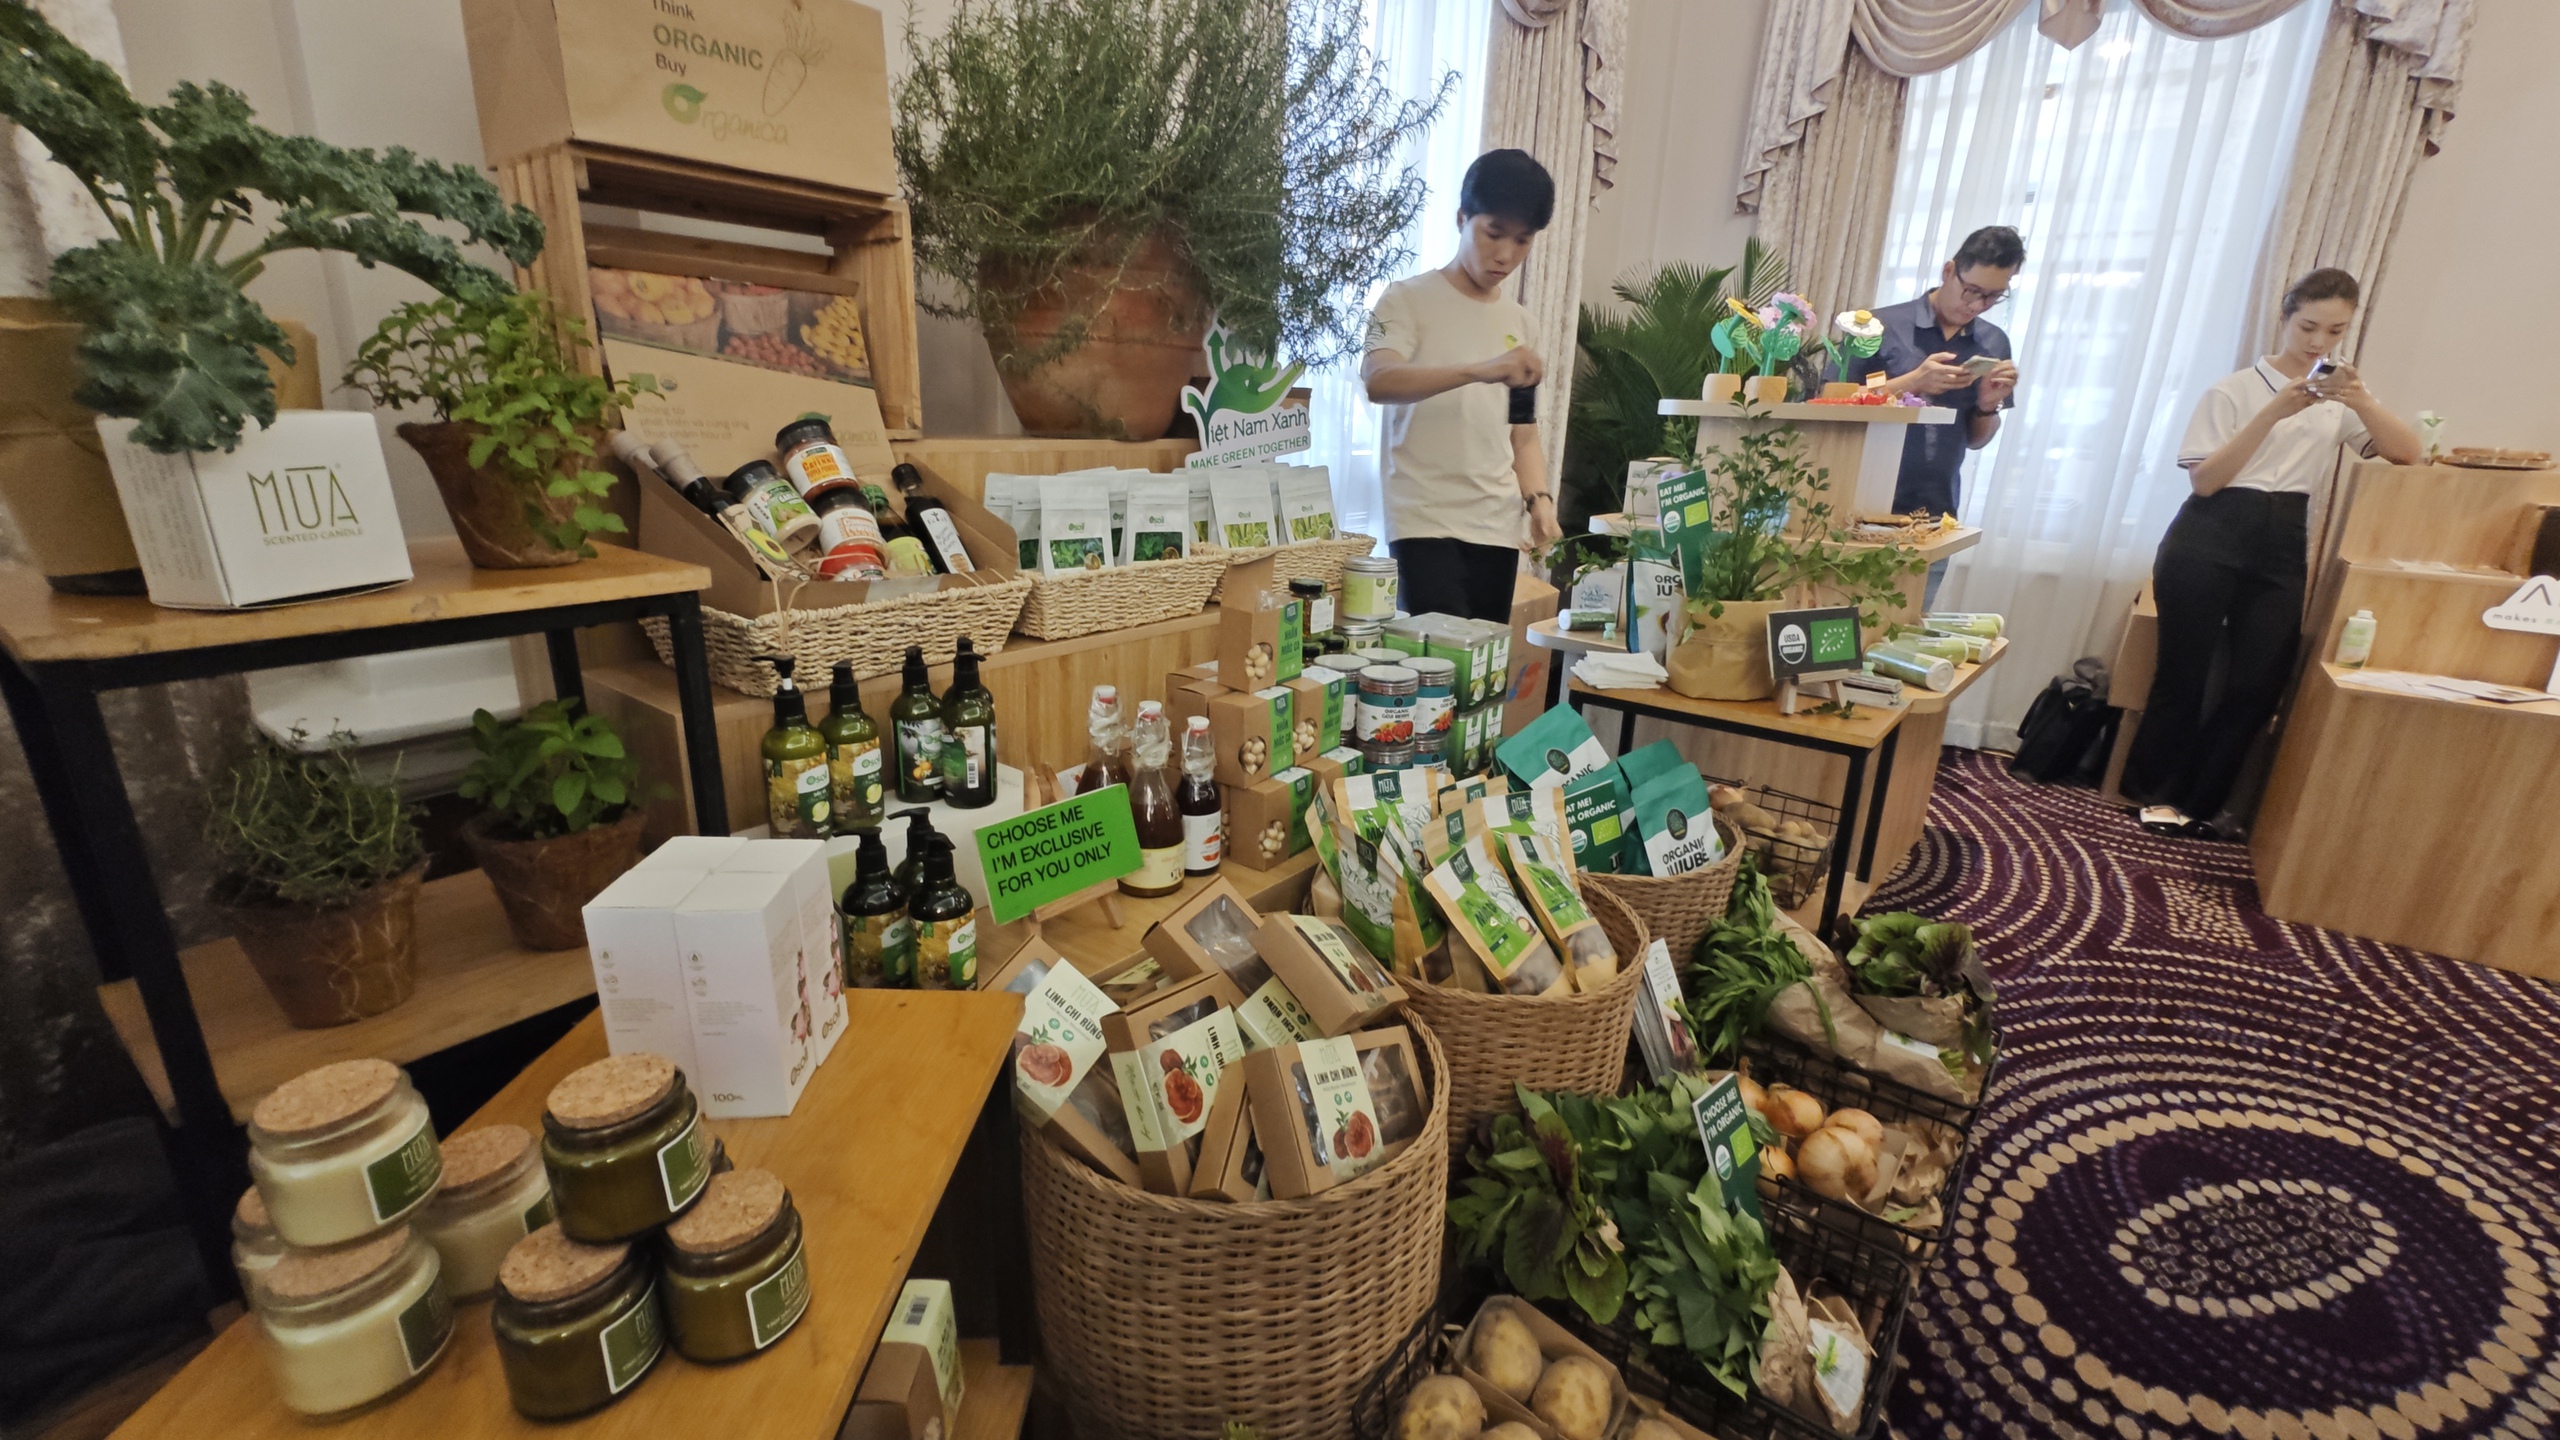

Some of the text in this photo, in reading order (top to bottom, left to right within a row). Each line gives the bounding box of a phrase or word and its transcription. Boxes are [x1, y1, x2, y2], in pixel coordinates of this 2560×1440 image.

[653, 24, 764, 71] ORGANIC
[655, 53, 686, 77] Buy
[1233, 418, 1269, 439] Nam
[1272, 408, 1308, 431] Xanh
[1190, 435, 1309, 469] MAKE GREEN TOGETHER
[1659, 486, 1673, 498] EAT
[1673, 486, 1706, 504] ORGANIC
[263, 526, 364, 547] SCENTED CANDLE
[2493, 613, 2537, 624] makes
[1783, 633, 1801, 643] USDA
[1565, 802, 1576, 815] AT
[1577, 799, 1617, 822] ORGANIC
[987, 805, 1085, 850] CHOOSE ME
[992, 821, 1105, 874] I'M EXCLUSIVE
[998, 841, 1112, 897] FOR YOU ONLY
[1044, 987, 1067, 1009] LINH
[1064, 1004, 1082, 1021] CHI
[1207, 1025, 1221, 1050] LINH
[1314, 1071, 1330, 1086] LINH
[1330, 1069, 1342, 1083] CHI
[1701, 1094, 1728, 1125] CHOOSE
[1716, 1101, 1744, 1132] ORGANIC
